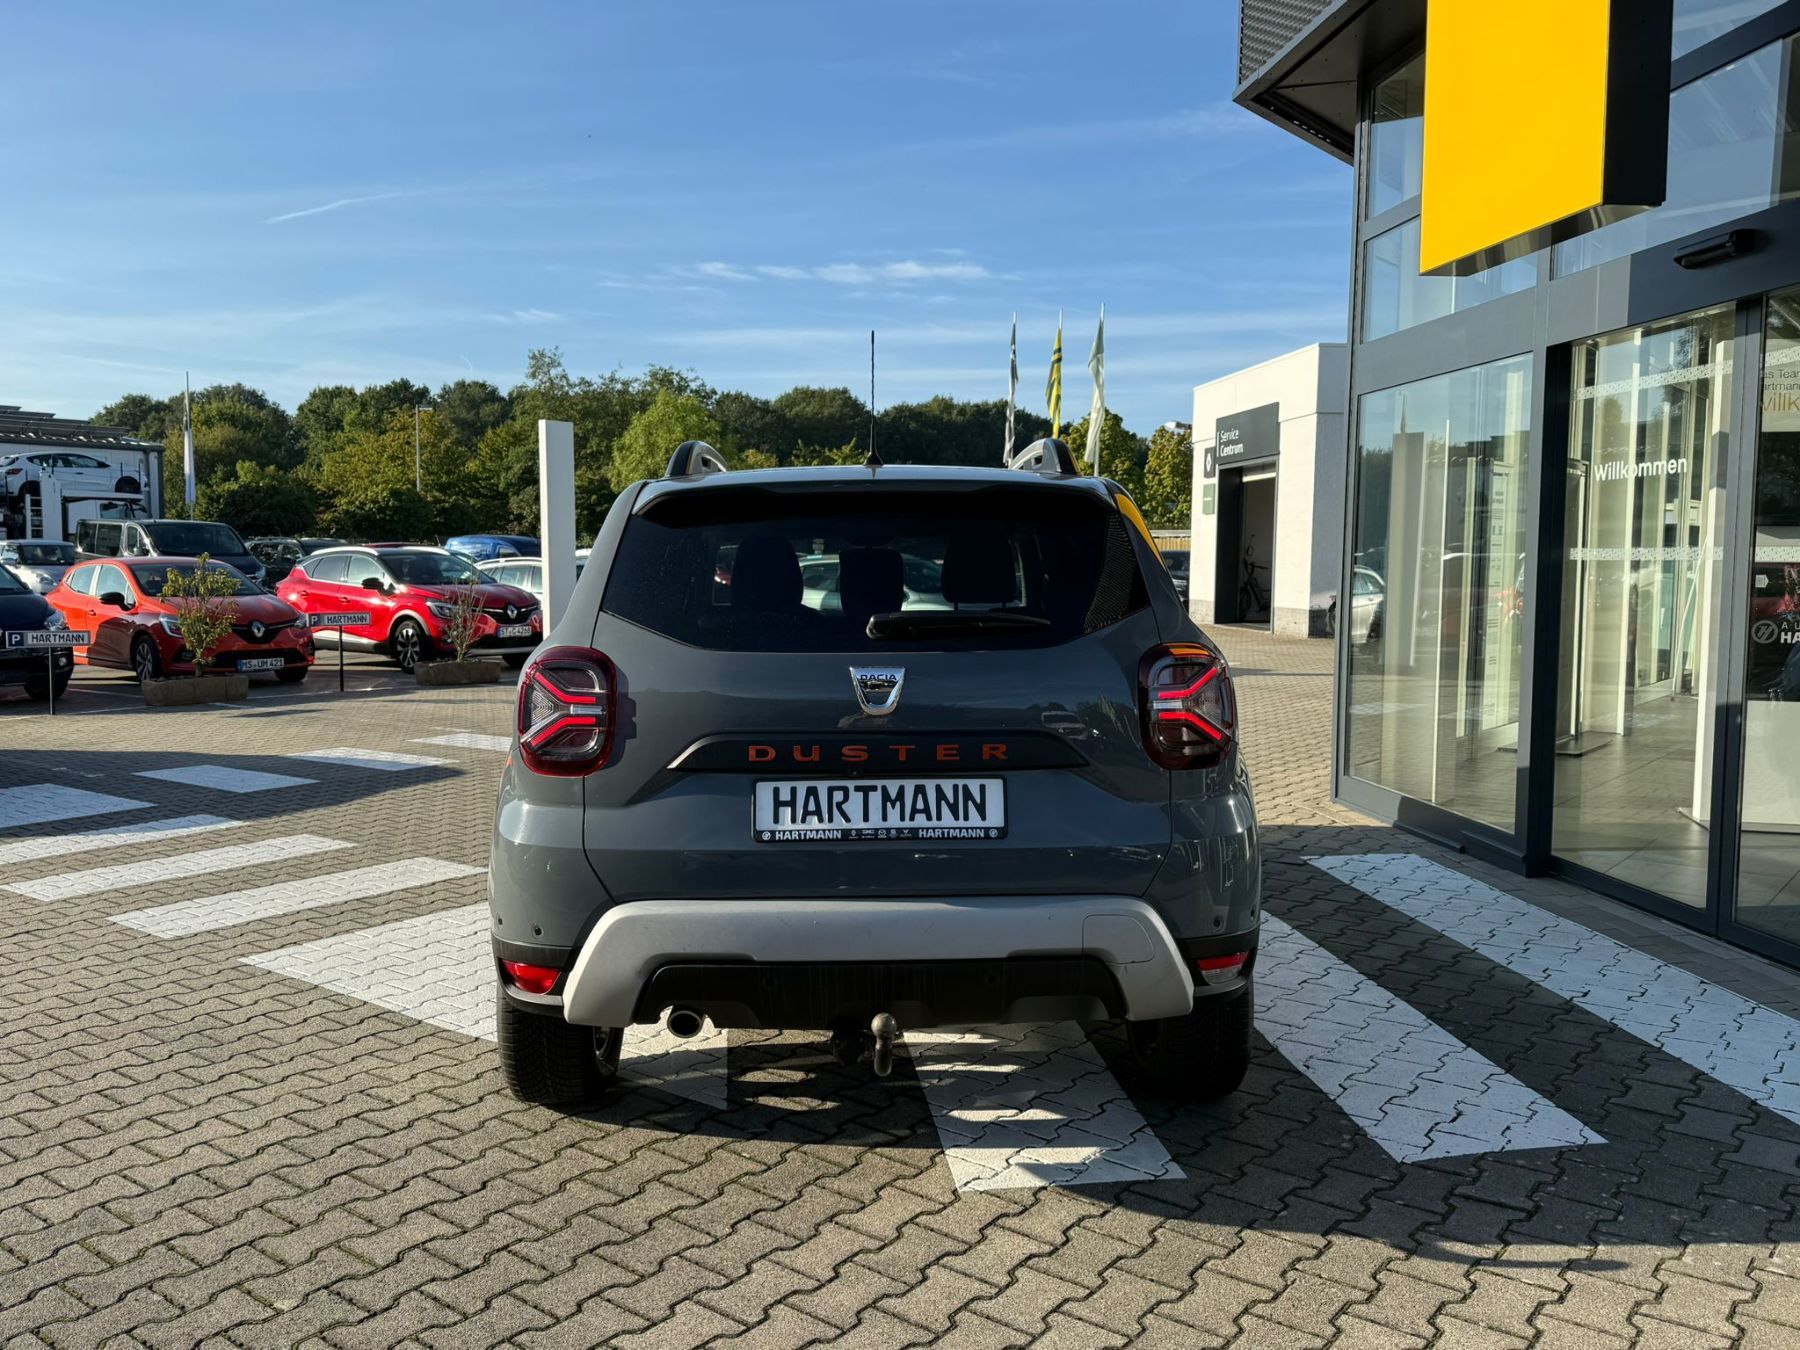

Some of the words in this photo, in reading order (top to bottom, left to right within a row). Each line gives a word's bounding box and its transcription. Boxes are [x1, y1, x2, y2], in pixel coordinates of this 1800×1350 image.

[1220, 428, 1239, 443] Service
[1220, 443, 1244, 457] Centrum
[1594, 458, 1687, 481] Willkommen
[311, 616, 317, 624] P
[327, 614, 367, 624] HARTMANN
[12, 634, 20, 645] P
[31, 634, 85, 644] HARTMANN
[748, 743, 1009, 762] DUSTER
[772, 784, 987, 825] HARTMANN
[775, 829, 842, 840] HARTMANN
[919, 828, 985, 839] HARTMANN
